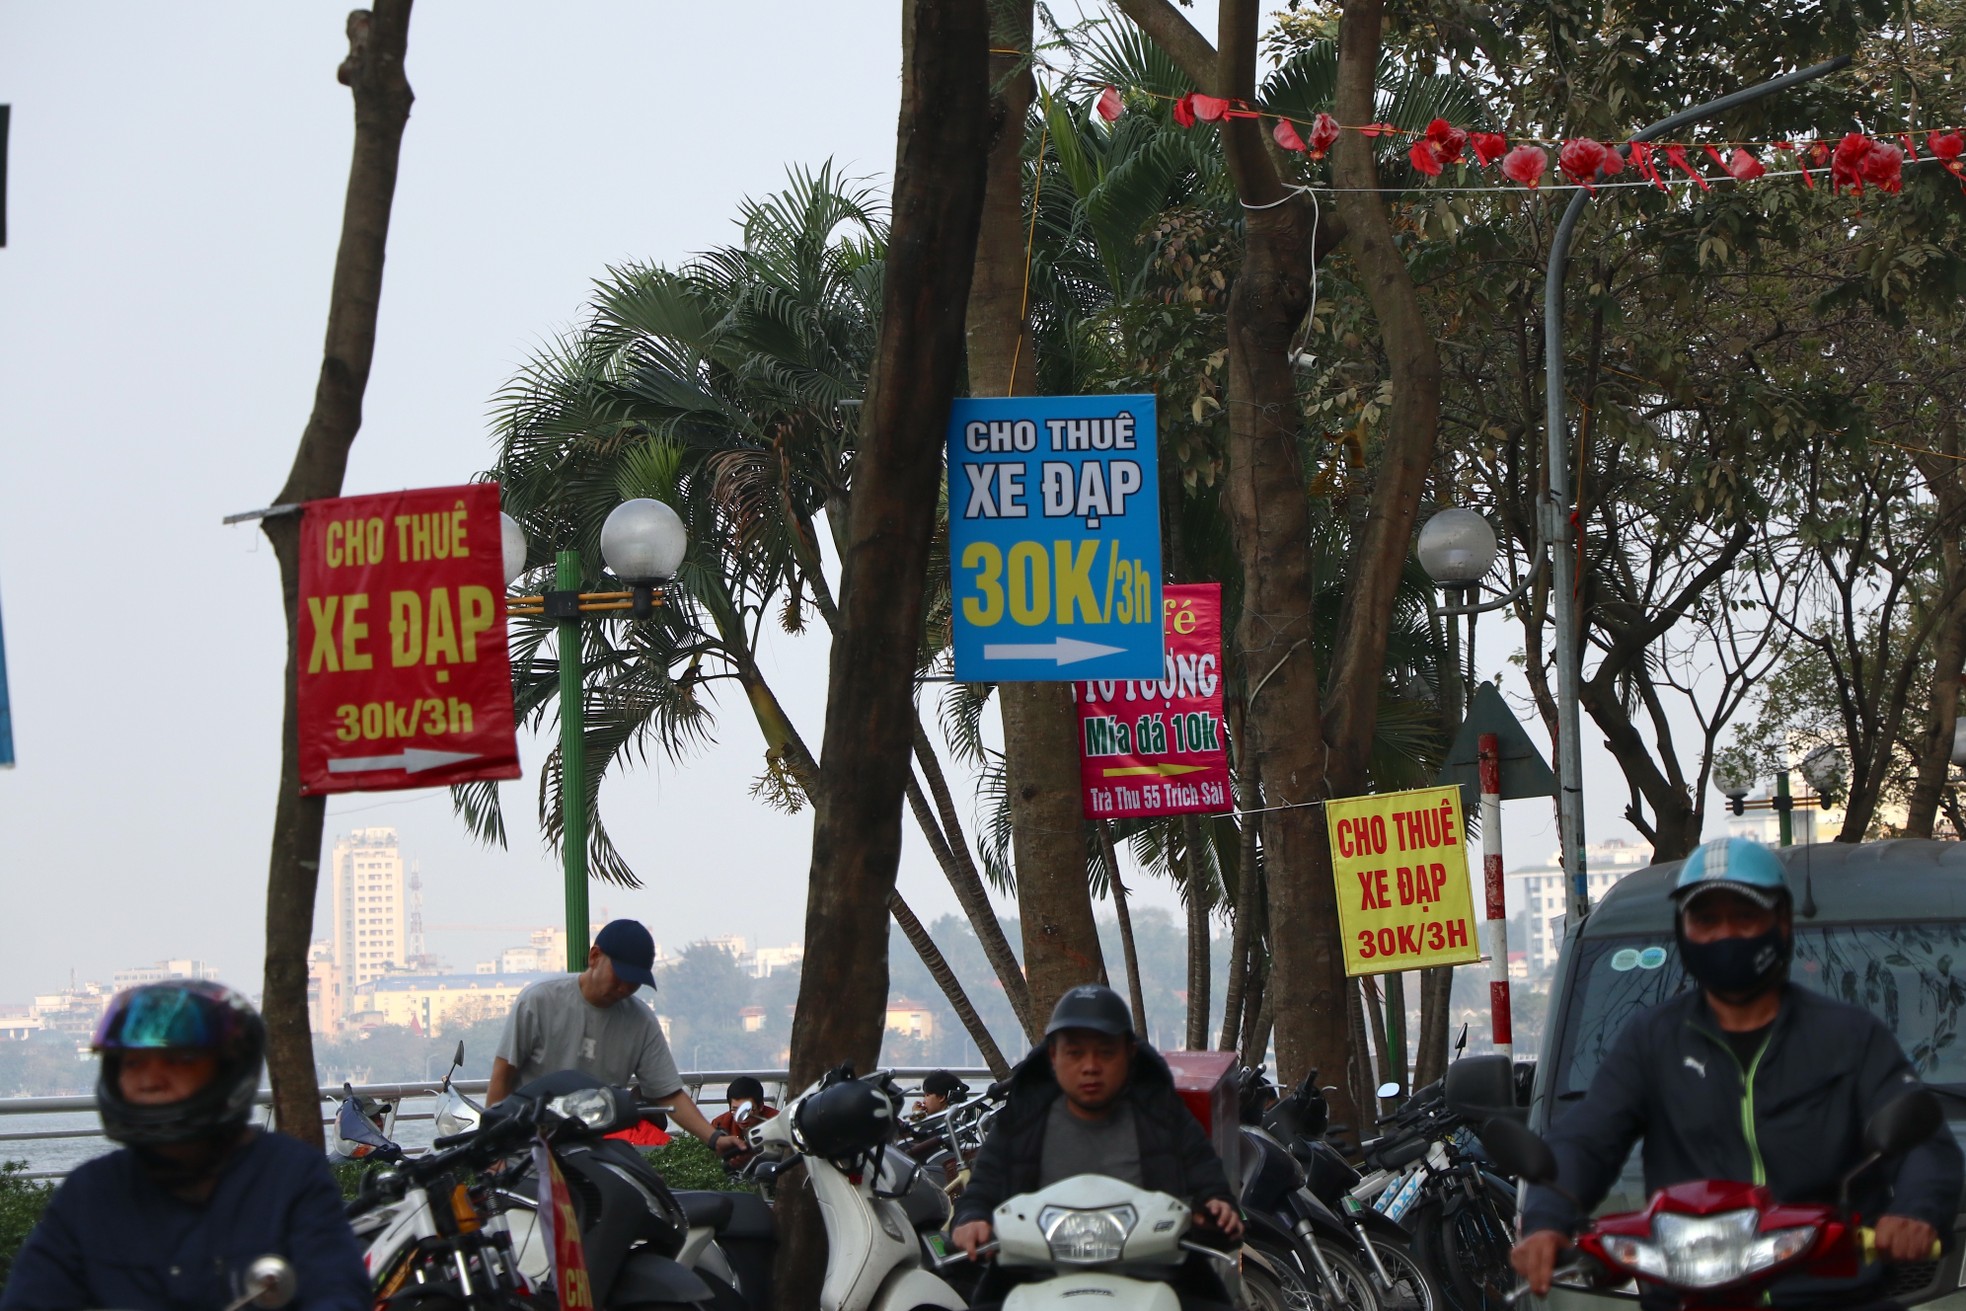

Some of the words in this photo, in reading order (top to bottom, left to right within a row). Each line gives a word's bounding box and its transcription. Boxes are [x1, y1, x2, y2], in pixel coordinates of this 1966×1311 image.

[965, 420, 1037, 453] CHO
[1045, 411, 1136, 451] THUÊ
[963, 461, 1028, 519] XE
[1041, 459, 1142, 530] ĐẠP
[326, 517, 384, 568] CHO
[395, 500, 470, 562] THUÊ
[961, 539, 1152, 627] 30K/3h
[307, 593, 373, 674] XE
[389, 585, 495, 683] ĐẠP
[1163, 598, 1196, 636] fé
[336, 697, 474, 741] 30k/3h
[1084, 714, 1132, 757] Mía
[1136, 713, 1168, 755] đá
[1171, 711, 1221, 754] 10k
[1090, 788, 1113, 812] Trà
[1115, 786, 1141, 809] Thu
[1143, 785, 1161, 809] 55
[1163, 783, 1199, 808] Trích
[1201, 781, 1224, 806] Sài
[1337, 815, 1388, 858] CHO
[1391, 798, 1457, 851] THUÊ
[1357, 869, 1392, 911] XE
[1396, 863, 1447, 913] ĐẠP
[1357, 919, 1468, 959] 30K/3H
